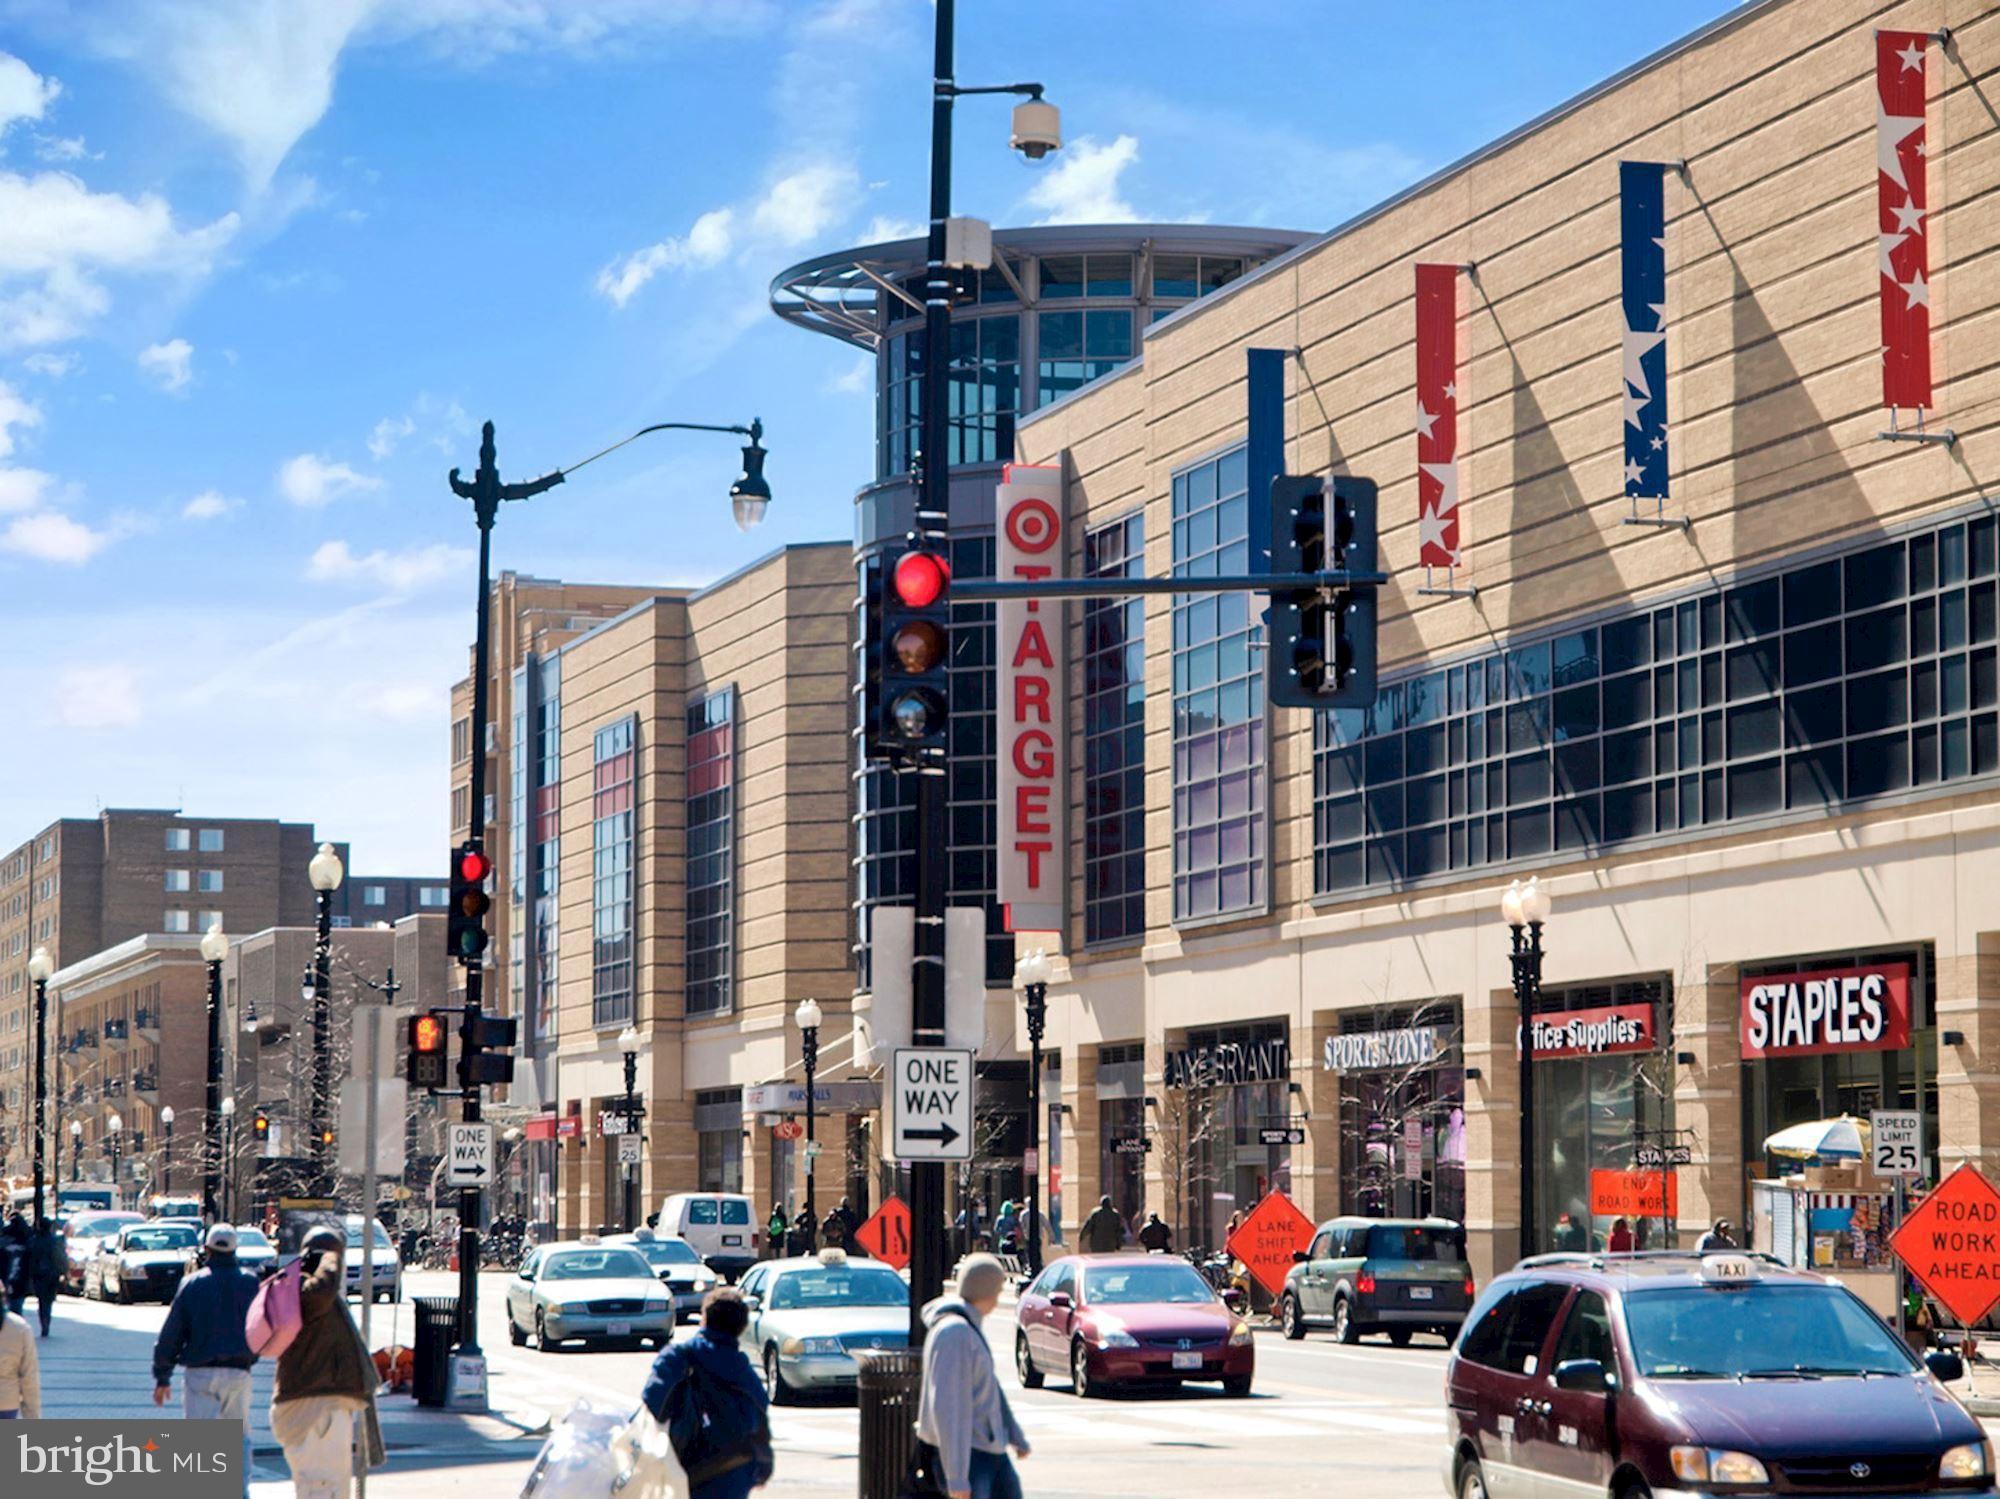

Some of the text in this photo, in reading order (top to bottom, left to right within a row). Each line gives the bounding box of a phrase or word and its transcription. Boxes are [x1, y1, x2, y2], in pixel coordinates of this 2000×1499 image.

[1012, 566, 1054, 888] TARGET
[1748, 974, 1884, 1049] STAPLES
[1516, 1015, 1639, 1053] fice Supplies
[1216, 1039, 1285, 1086] BRYANT
[906, 1059, 958, 1084] ONE
[905, 1091, 959, 1114] WAY
[1877, 1118, 1917, 1129] SPEED
[456, 1129, 486, 1143] ONE
[1881, 1132, 1912, 1142] LIMIT
[455, 1147, 487, 1160] WAY
[622, 1150, 637, 1161] 25
[1638, 1148, 1690, 1163] STAS
[1878, 1146, 1916, 1169] 25
[1623, 1178, 1646, 1190] END
[1599, 1196, 1630, 1208] ROAD
[1936, 1202, 1997, 1221] ROAD
[1257, 1221, 1295, 1232] LANE
[1257, 1237, 1295, 1249] SHIFT
[1932, 1232, 1997, 1253] WORK
[1253, 1254, 1293, 1265] AHEA
[1717, 1264, 1747, 1277] TAXI
